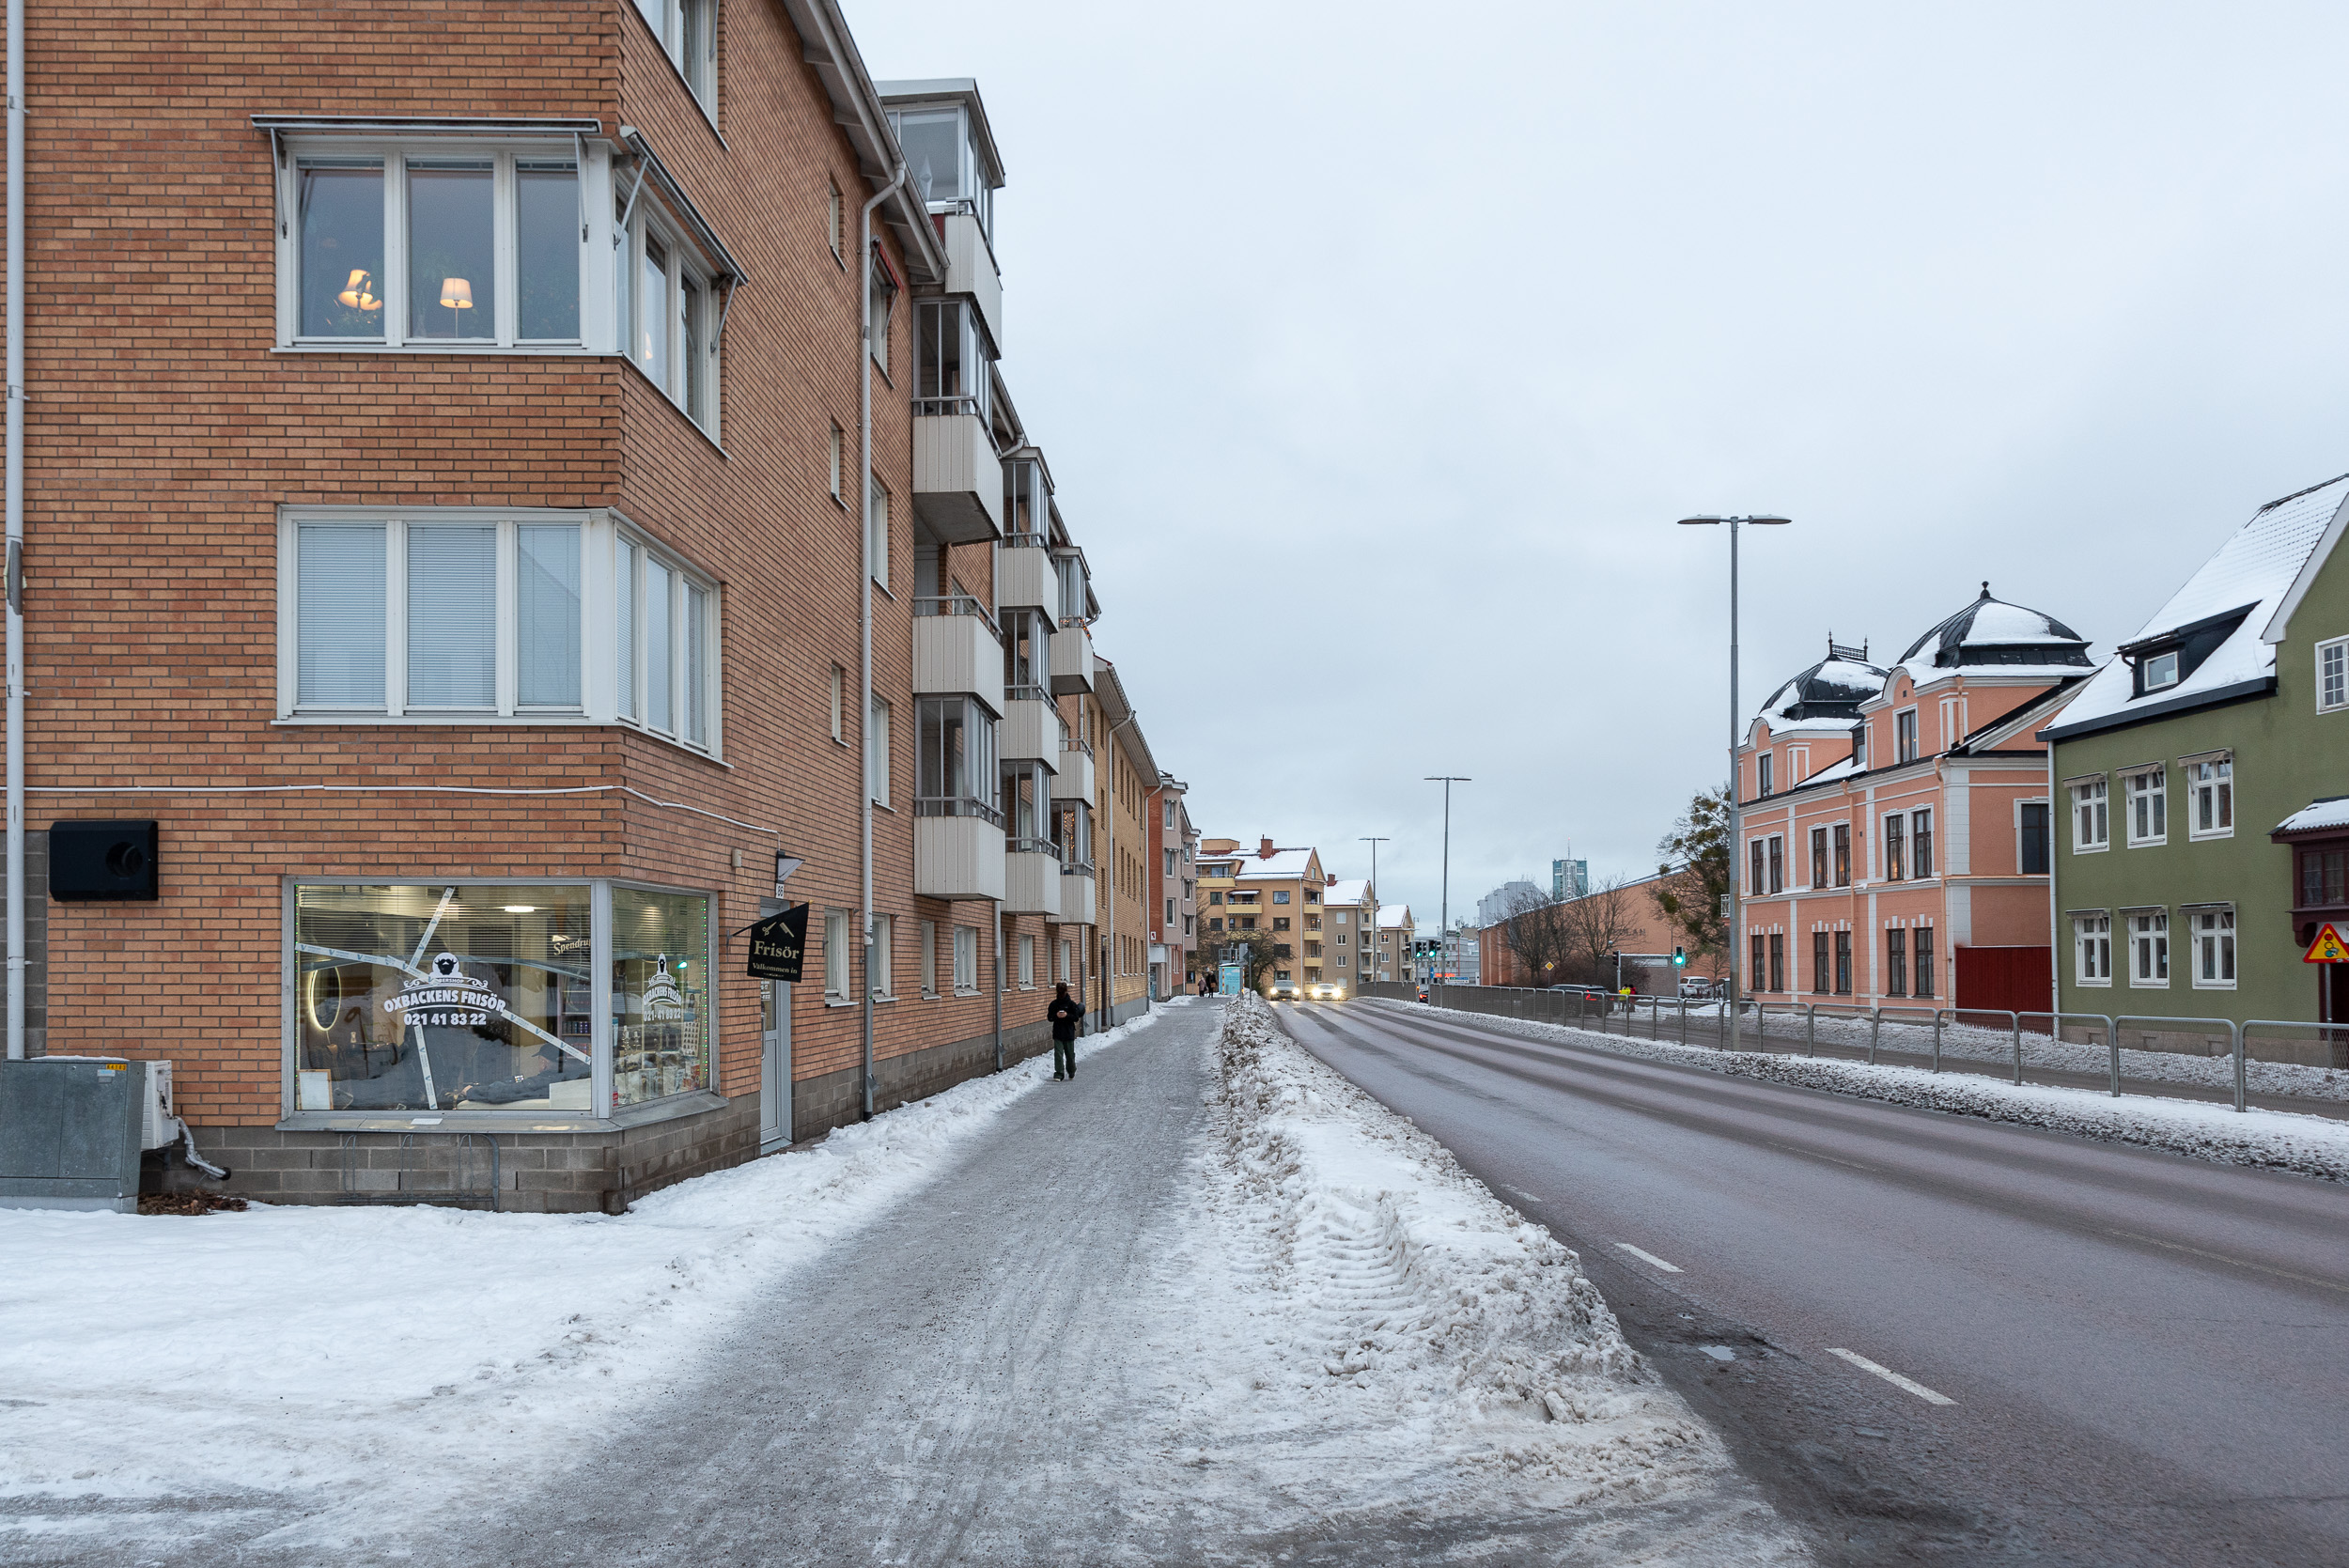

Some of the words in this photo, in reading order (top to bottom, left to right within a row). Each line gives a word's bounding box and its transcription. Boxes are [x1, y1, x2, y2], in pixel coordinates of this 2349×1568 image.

[754, 939, 800, 959] Frisör
[383, 989, 459, 1013] OXBACKENS
[460, 991, 506, 1013] FRISÖR
[403, 1014, 428, 1026] 021
[430, 1014, 446, 1026] 41
[450, 1014, 468, 1026] 83
[470, 1014, 487, 1026] 22
[674, 1007, 681, 1019] 22
